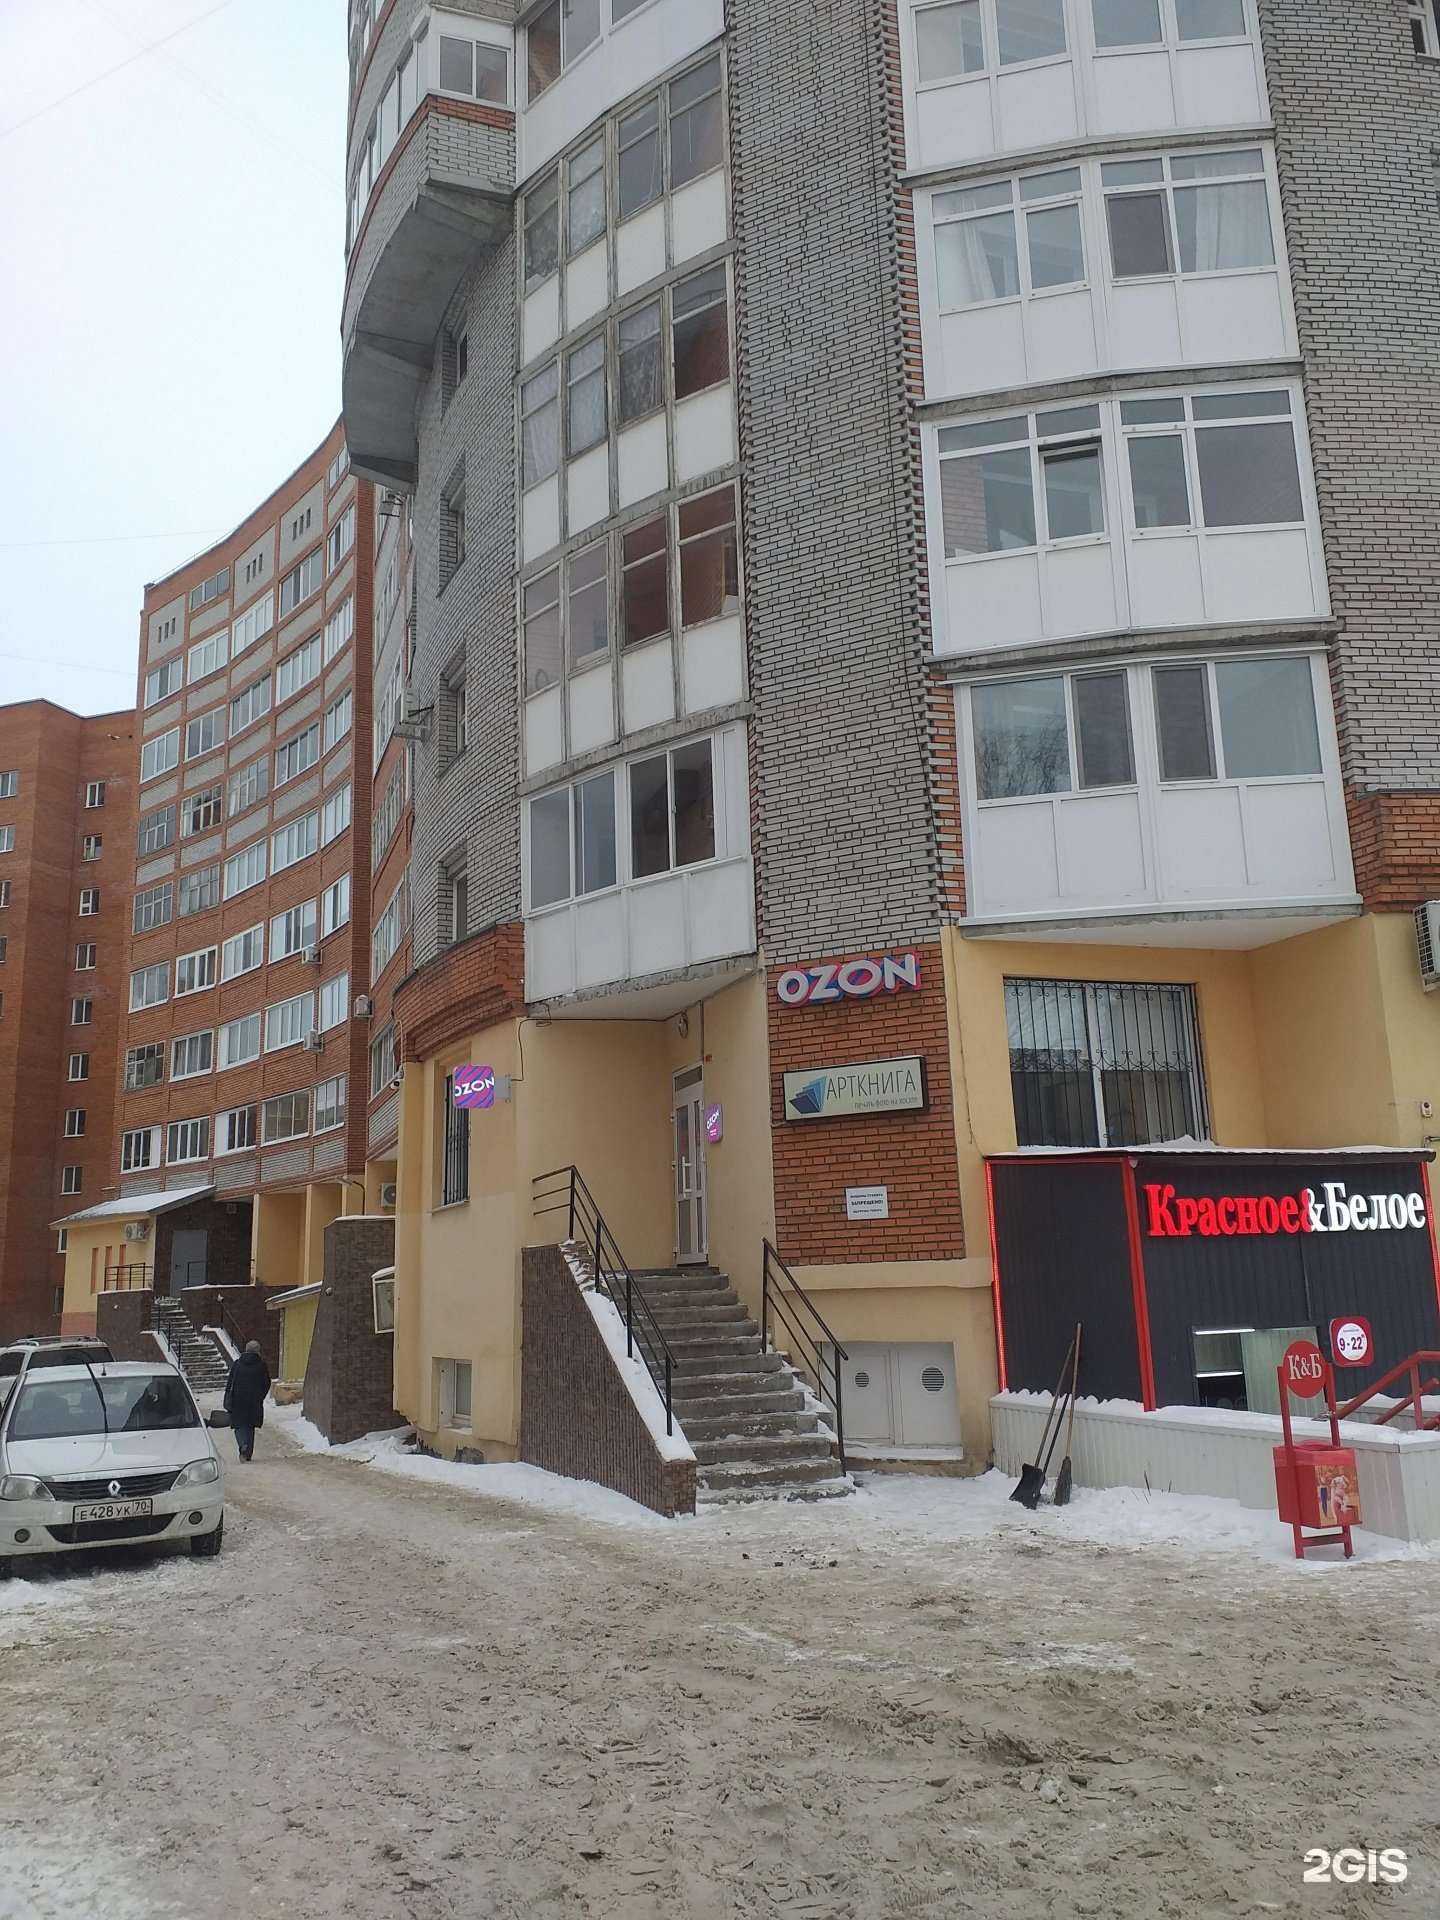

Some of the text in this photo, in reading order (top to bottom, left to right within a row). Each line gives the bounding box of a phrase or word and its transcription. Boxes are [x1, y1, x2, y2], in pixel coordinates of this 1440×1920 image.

[777, 953, 917, 1003] OZON
[454, 1076, 495, 1097] OZON
[827, 1069, 916, 1100] АРТКНИГА
[1288, 1353, 1322, 1380] К&Б
